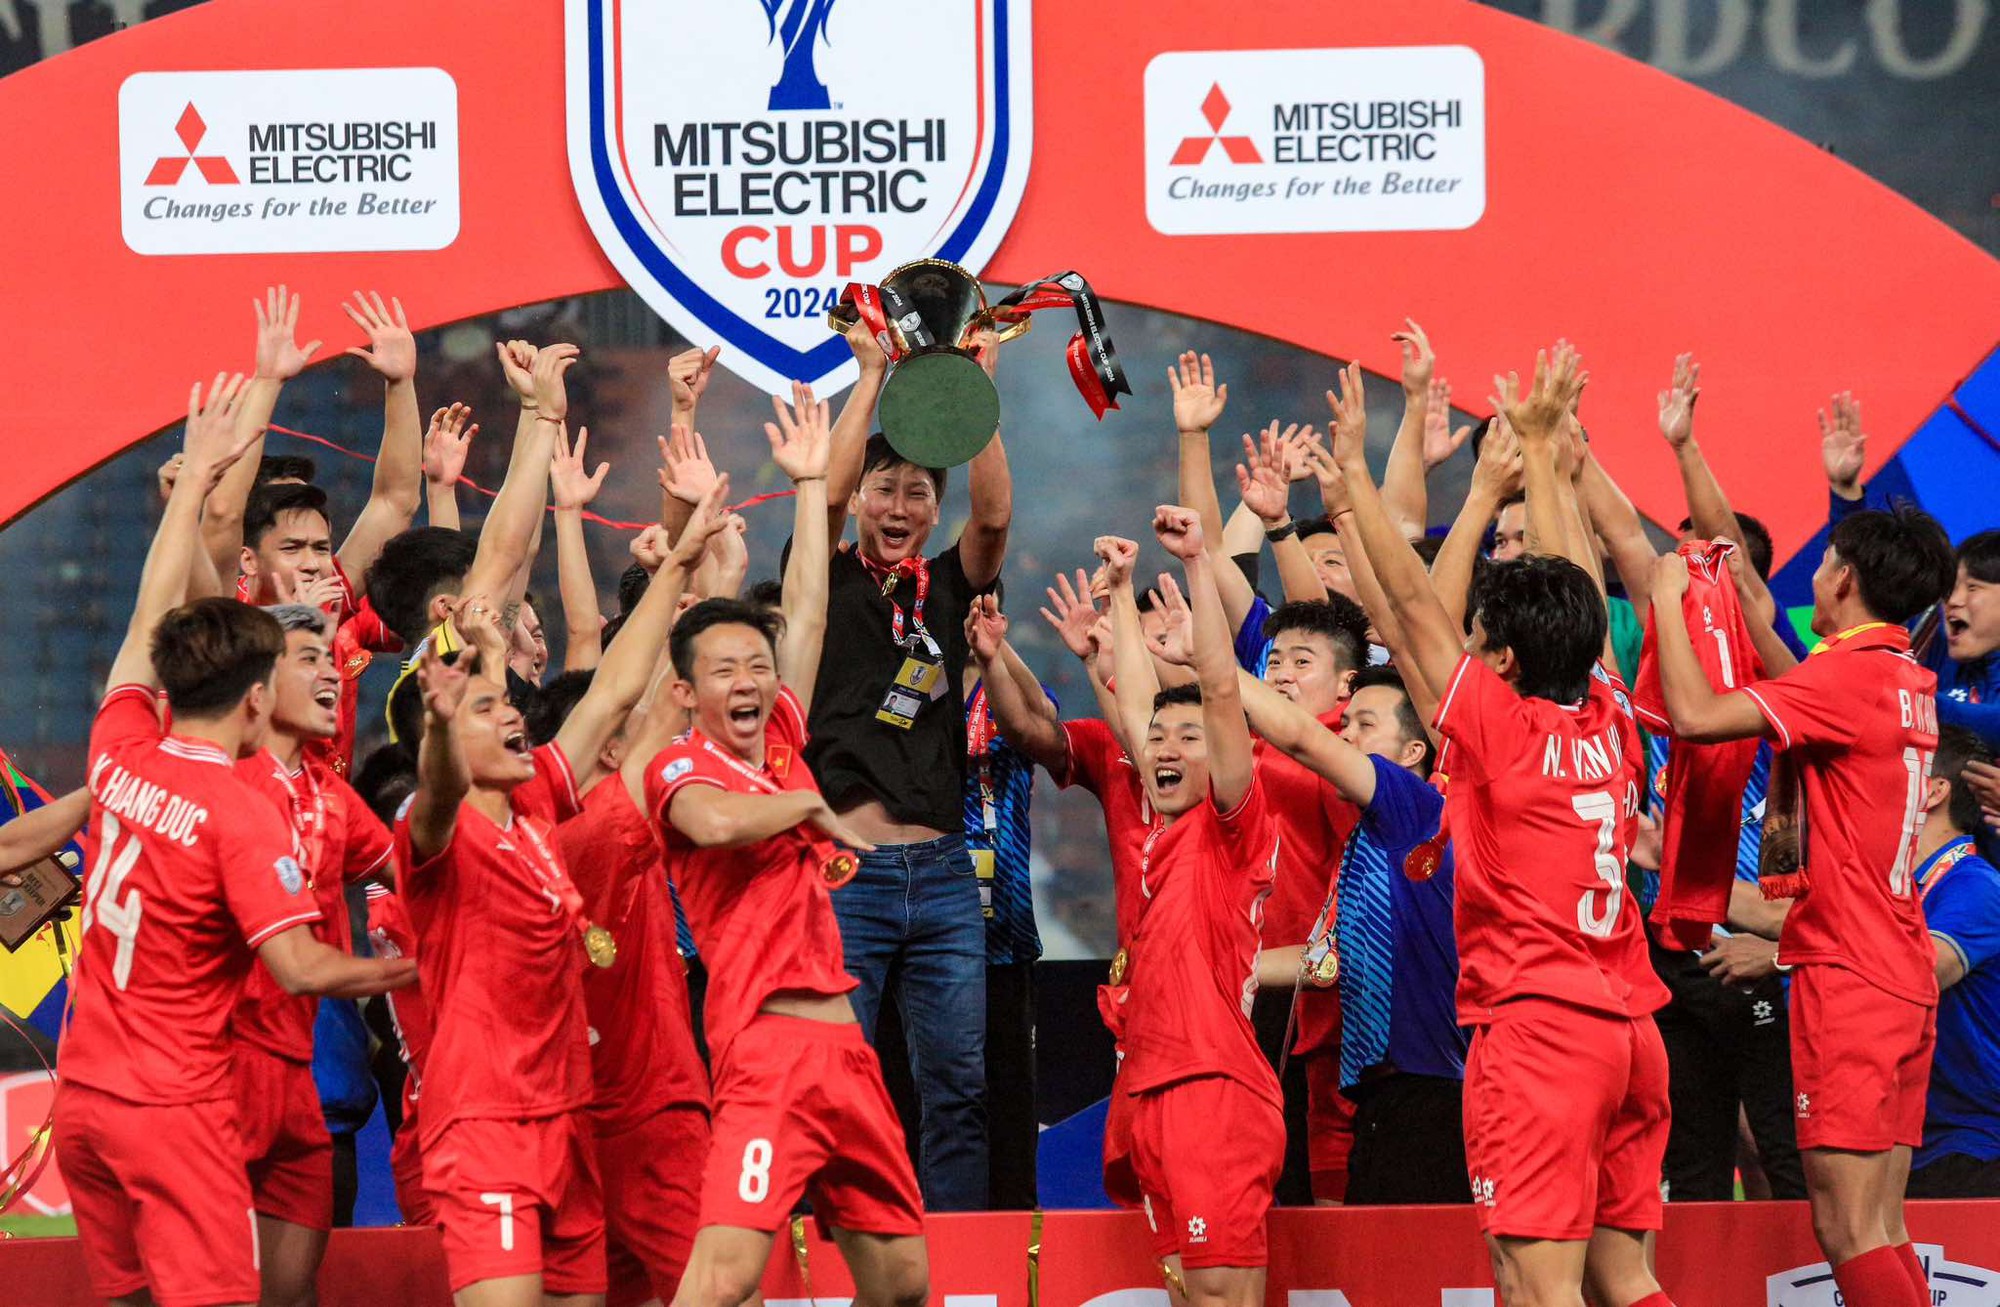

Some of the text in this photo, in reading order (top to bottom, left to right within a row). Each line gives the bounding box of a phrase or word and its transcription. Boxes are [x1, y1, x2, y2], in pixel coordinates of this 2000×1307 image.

[248, 121, 436, 152] MITSUBISHI
[1273, 100, 1461, 132] MITSUBISHI
[653, 118, 946, 167] MITSUBISHI
[1274, 133, 1436, 163] ELECTRIC
[249, 154, 412, 184] ELECTRIC
[673, 169, 927, 216] ELECTRIC
[1167, 172, 1462, 202] Changes for the Better
[143, 193, 437, 222] Changes for the Better
[720, 224, 883, 280] CUP
[765, 287, 840, 318] 2024
[155, 795, 208, 848] DUC
[1571, 790, 1624, 938] 3
[82, 811, 143, 992] 14
[738, 1137, 774, 1203] 8
[480, 1191, 514, 1251] 7
